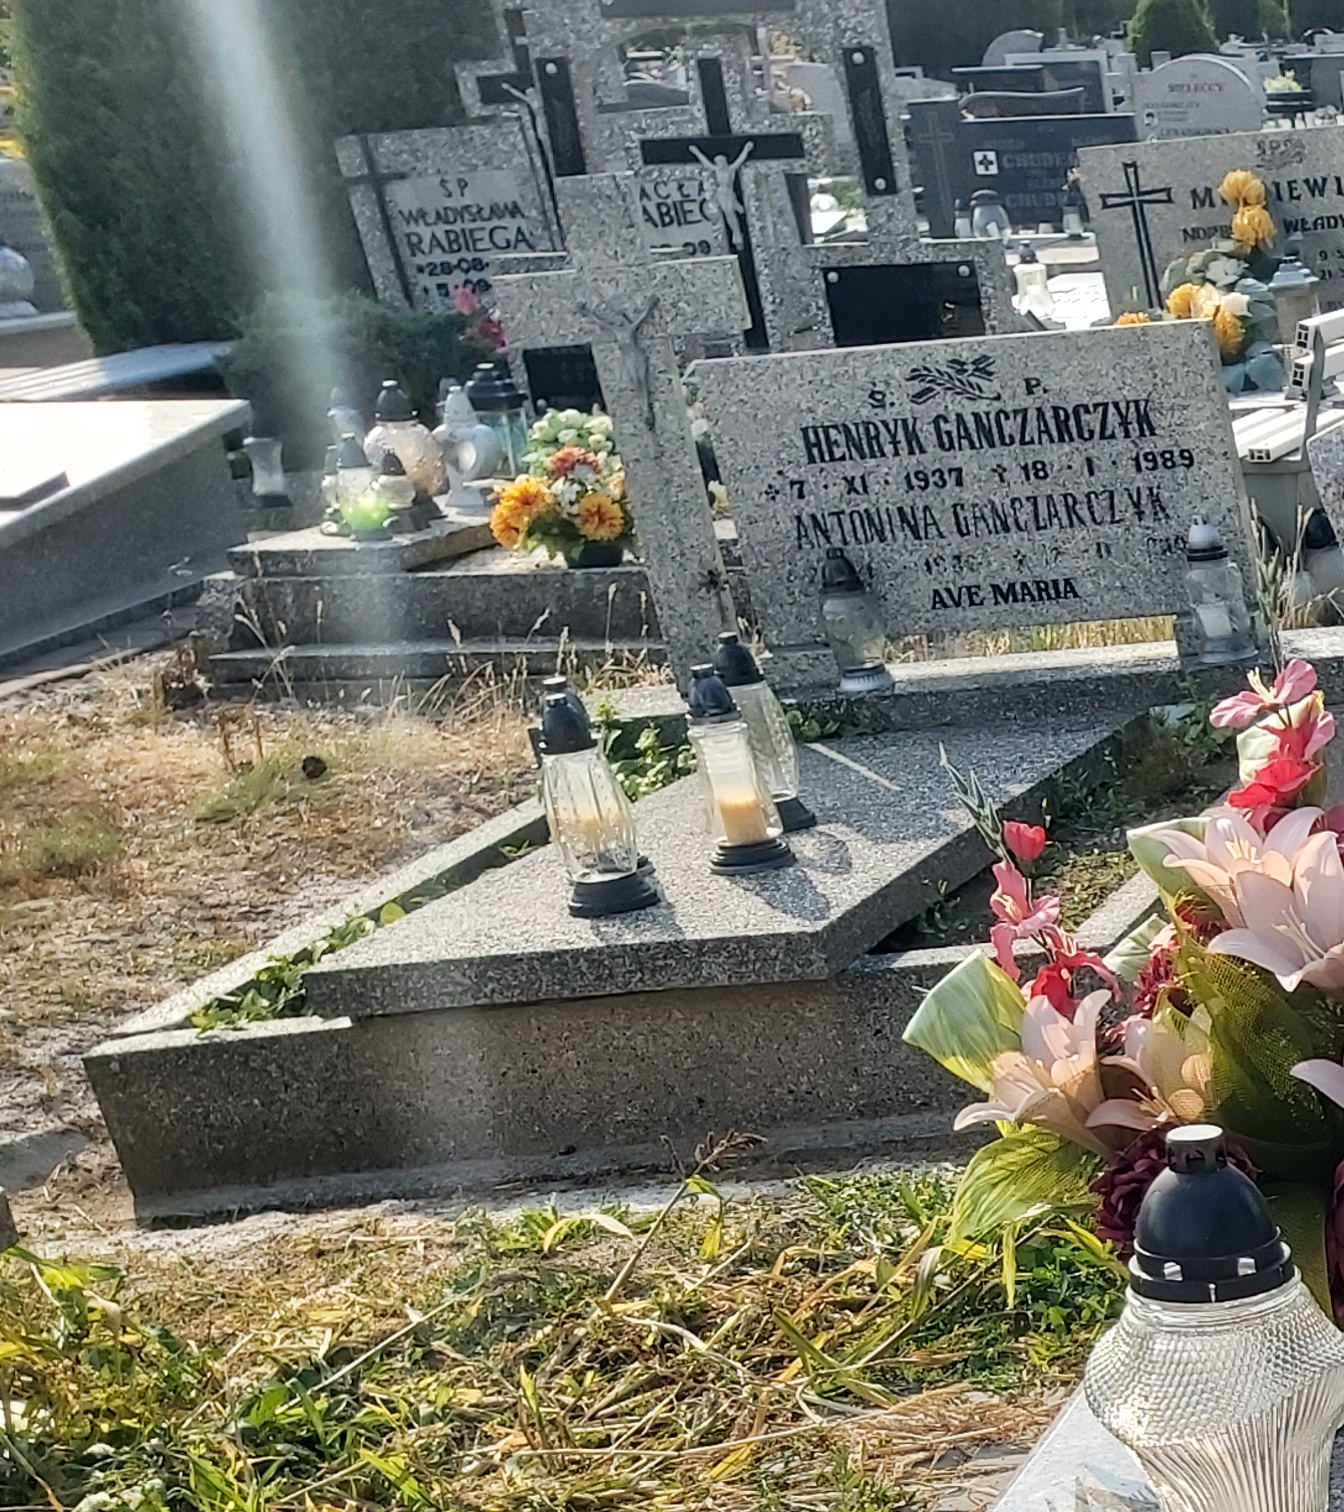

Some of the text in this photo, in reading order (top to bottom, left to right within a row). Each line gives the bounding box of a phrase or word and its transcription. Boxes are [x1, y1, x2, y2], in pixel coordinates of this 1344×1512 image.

[405, 225, 535, 257] RABIEGA
[801, 400, 1158, 465] HENRYK GANCZARCZYK
[904, 467, 965, 492] 1937
[1132, 449, 1195, 473] 1989
[793, 484, 1171, 550] ANTONINA GANCZARCZYK
[930, 577, 1082, 611] AVE MARIA
